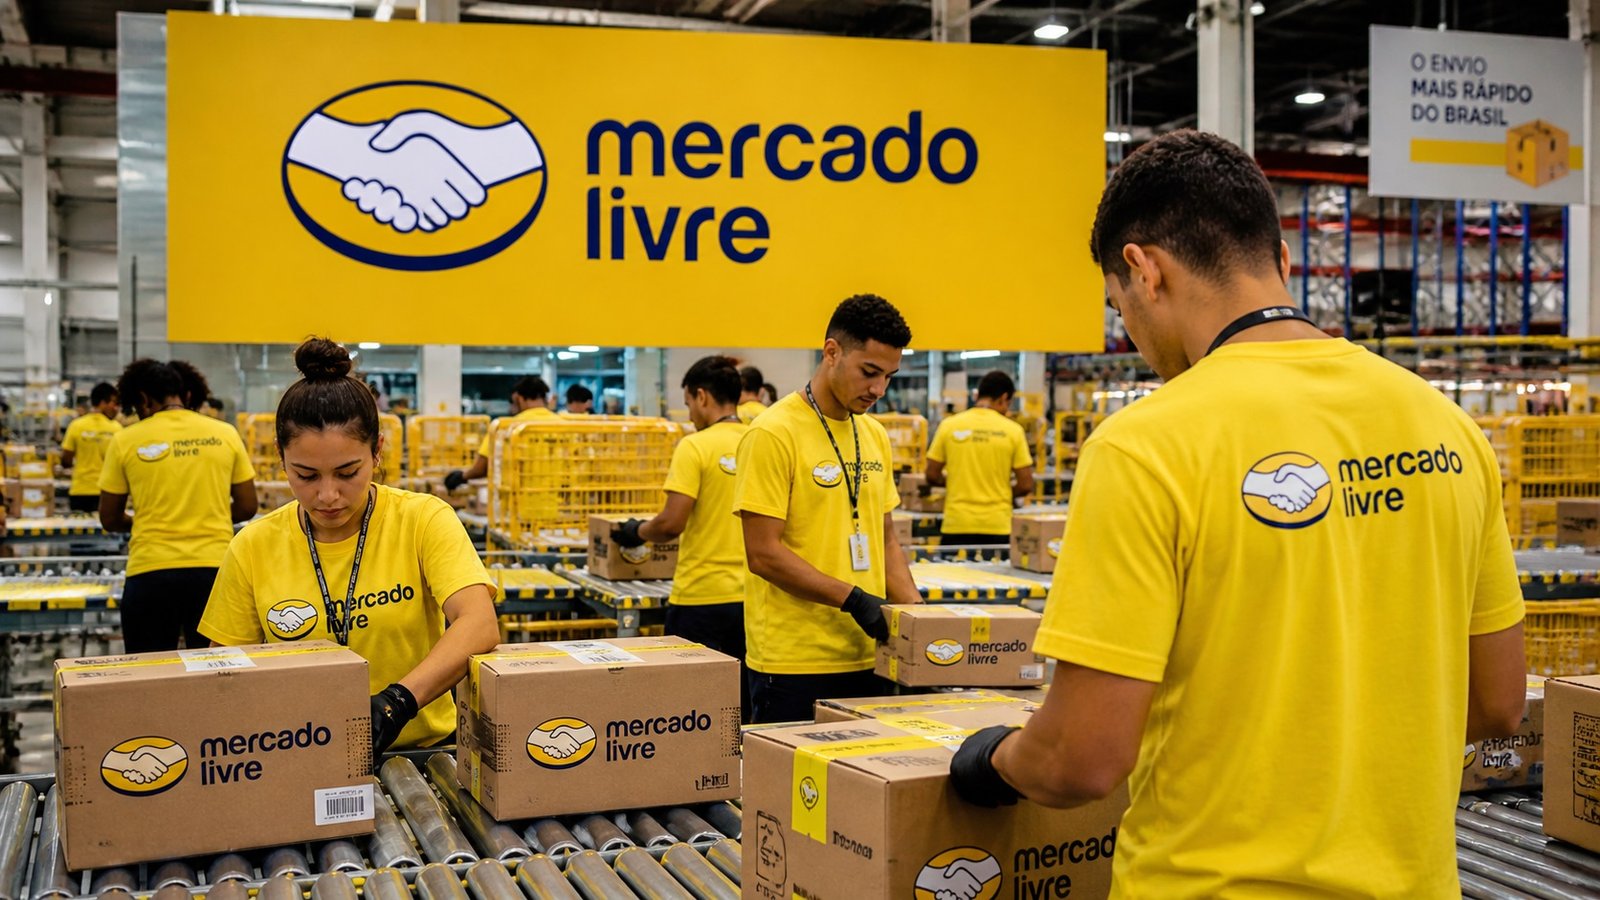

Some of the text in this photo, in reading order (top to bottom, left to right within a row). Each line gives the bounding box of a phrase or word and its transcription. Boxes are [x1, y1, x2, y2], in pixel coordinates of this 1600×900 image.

[1410, 52, 1487, 76] O ENVIO
[1411, 78, 1533, 104] MAIS RÁPIDO
[1411, 103, 1509, 126] DO BRASIL
[587, 110, 979, 185] mercado
[587, 186, 770, 264] livre
[843, 460, 884, 473] mrcado
[1338, 443, 1463, 482] mercado
[1342, 486, 1404, 518] livre
[968, 639, 1027, 653] mercado
[606, 710, 711, 739] mercado
[200, 721, 331, 758] mercado
[605, 740, 656, 762] livre
[201, 759, 263, 786] livre
[1013, 826, 1117, 873] mercad
[1013, 874, 1072, 900] livre
